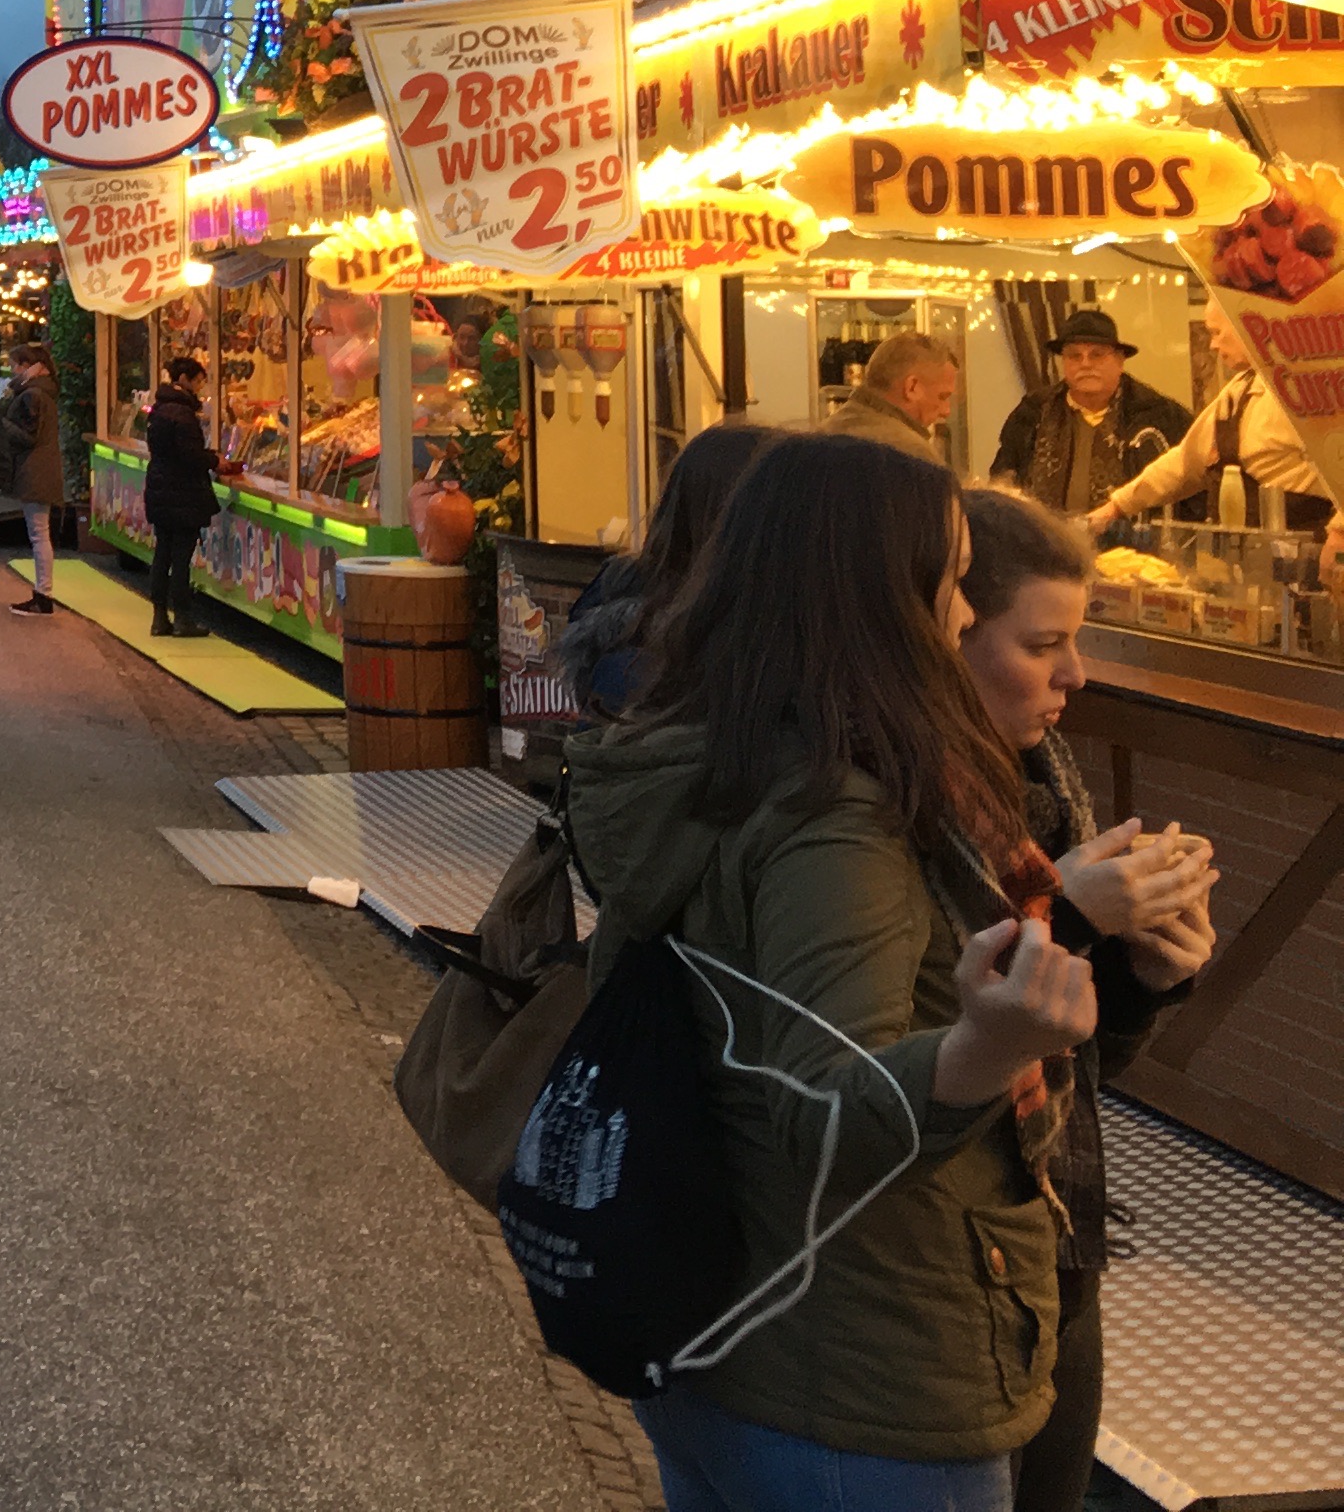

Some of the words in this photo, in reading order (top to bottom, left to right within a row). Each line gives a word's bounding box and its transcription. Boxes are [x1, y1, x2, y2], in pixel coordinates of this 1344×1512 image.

[448, 47, 559, 71] Zwillinge
[458, 25, 540, 53] DOM
[985, 21, 1008, 55] 4
[63, 48, 120, 91] XXL
[715, 14, 871, 119] Krakauer
[41, 73, 200, 144] POMMES
[400, 72, 449, 147] 2
[456, 60, 592, 129] BRAT-
[437, 98, 613, 185] WÜRSTE
[89, 191, 150, 205] Zwillinge
[96, 179, 140, 195] DOM
[849, 138, 1199, 219] Pommes
[63, 204, 91, 246] 2
[94, 199, 167, 236] BRAT-
[84, 218, 177, 267] WÜRSTE
[477, 217, 514, 243] nur
[597, 255, 610, 271] 4
[619, 248, 687, 270] KLEINE
